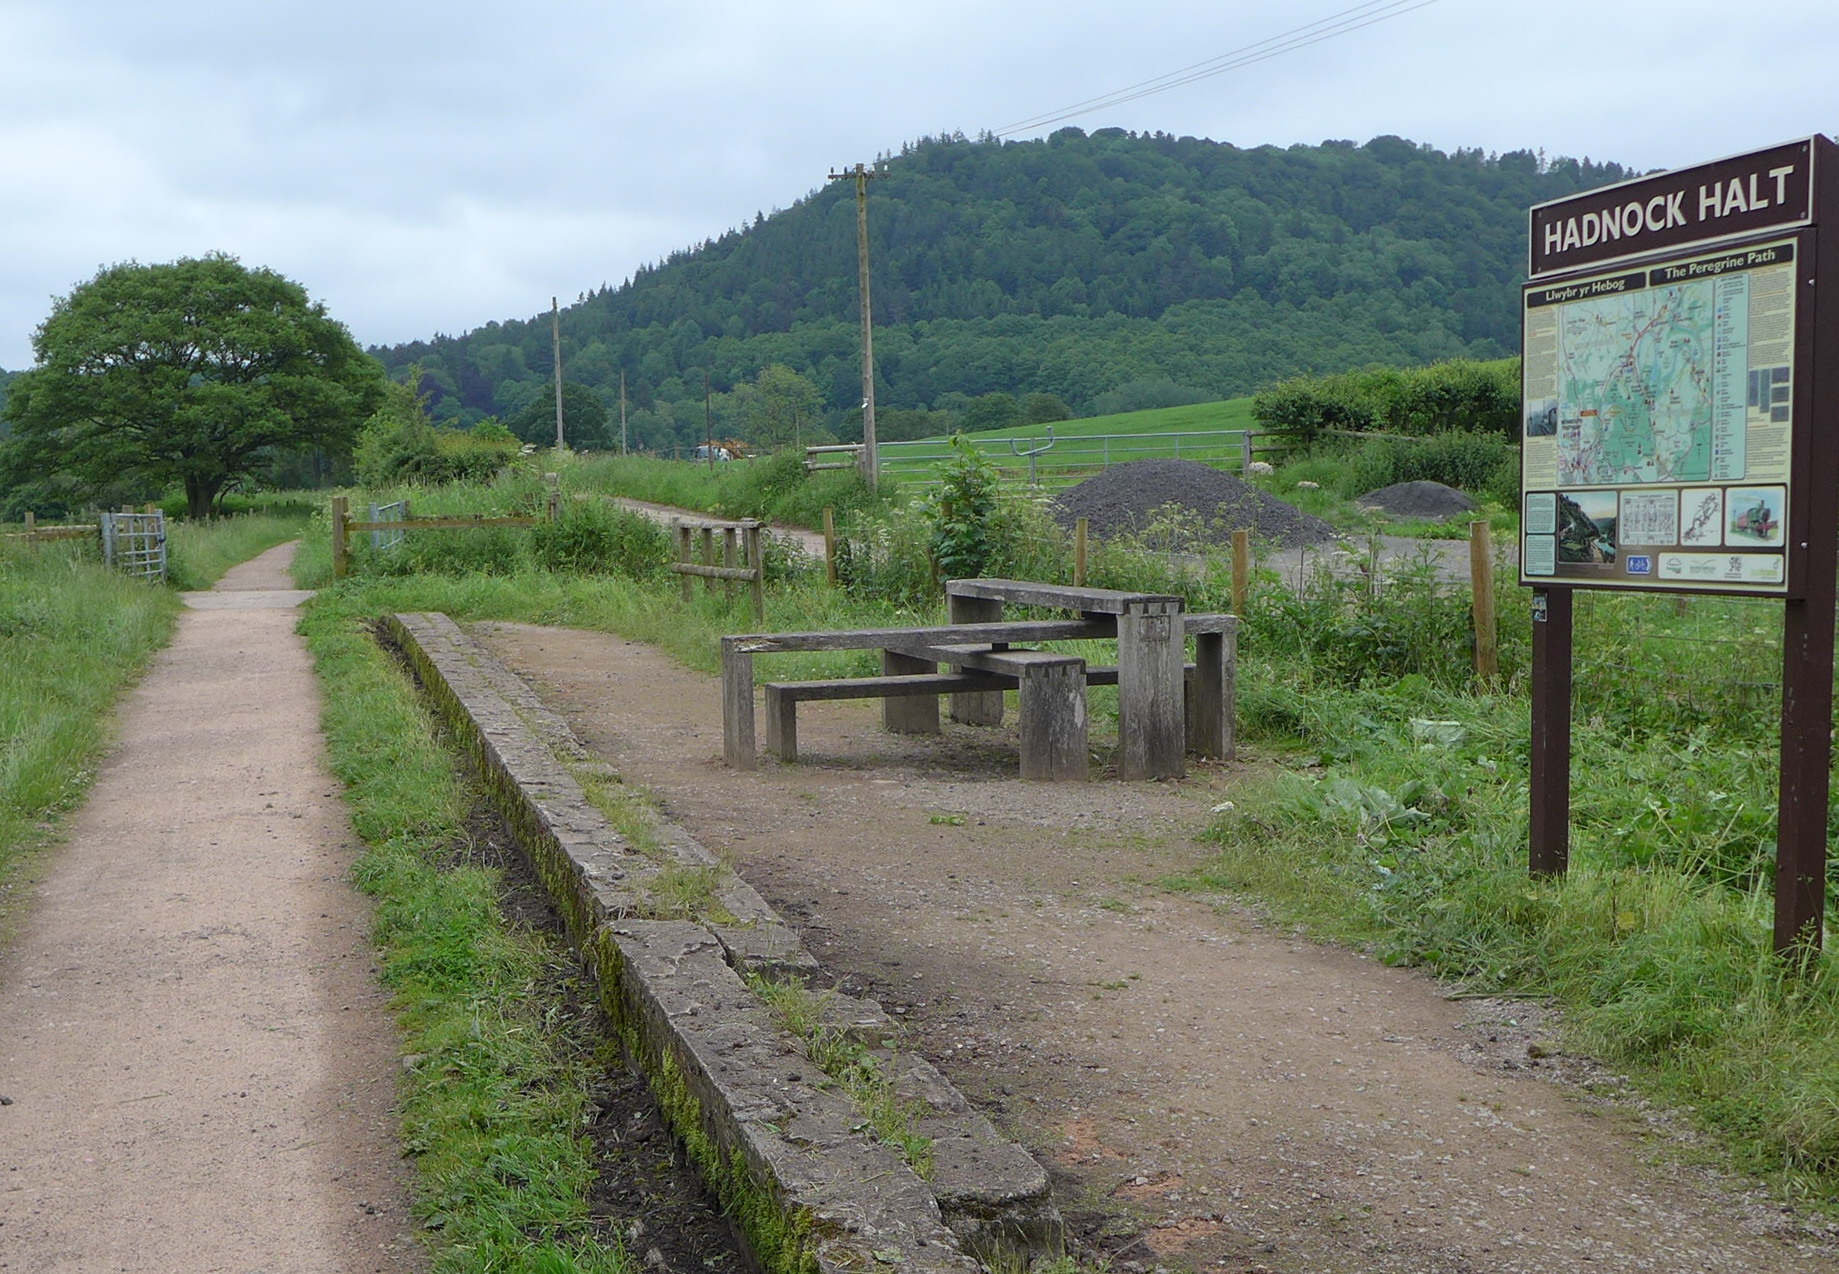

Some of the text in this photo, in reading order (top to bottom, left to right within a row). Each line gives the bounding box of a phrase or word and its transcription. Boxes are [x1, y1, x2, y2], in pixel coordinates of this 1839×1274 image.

[1544, 165, 1795, 256] HADNOCK HALT
[1664, 249, 1776, 280] The Peregrine Path
[1545, 280, 1625, 302] Llwybr yr Hebog
